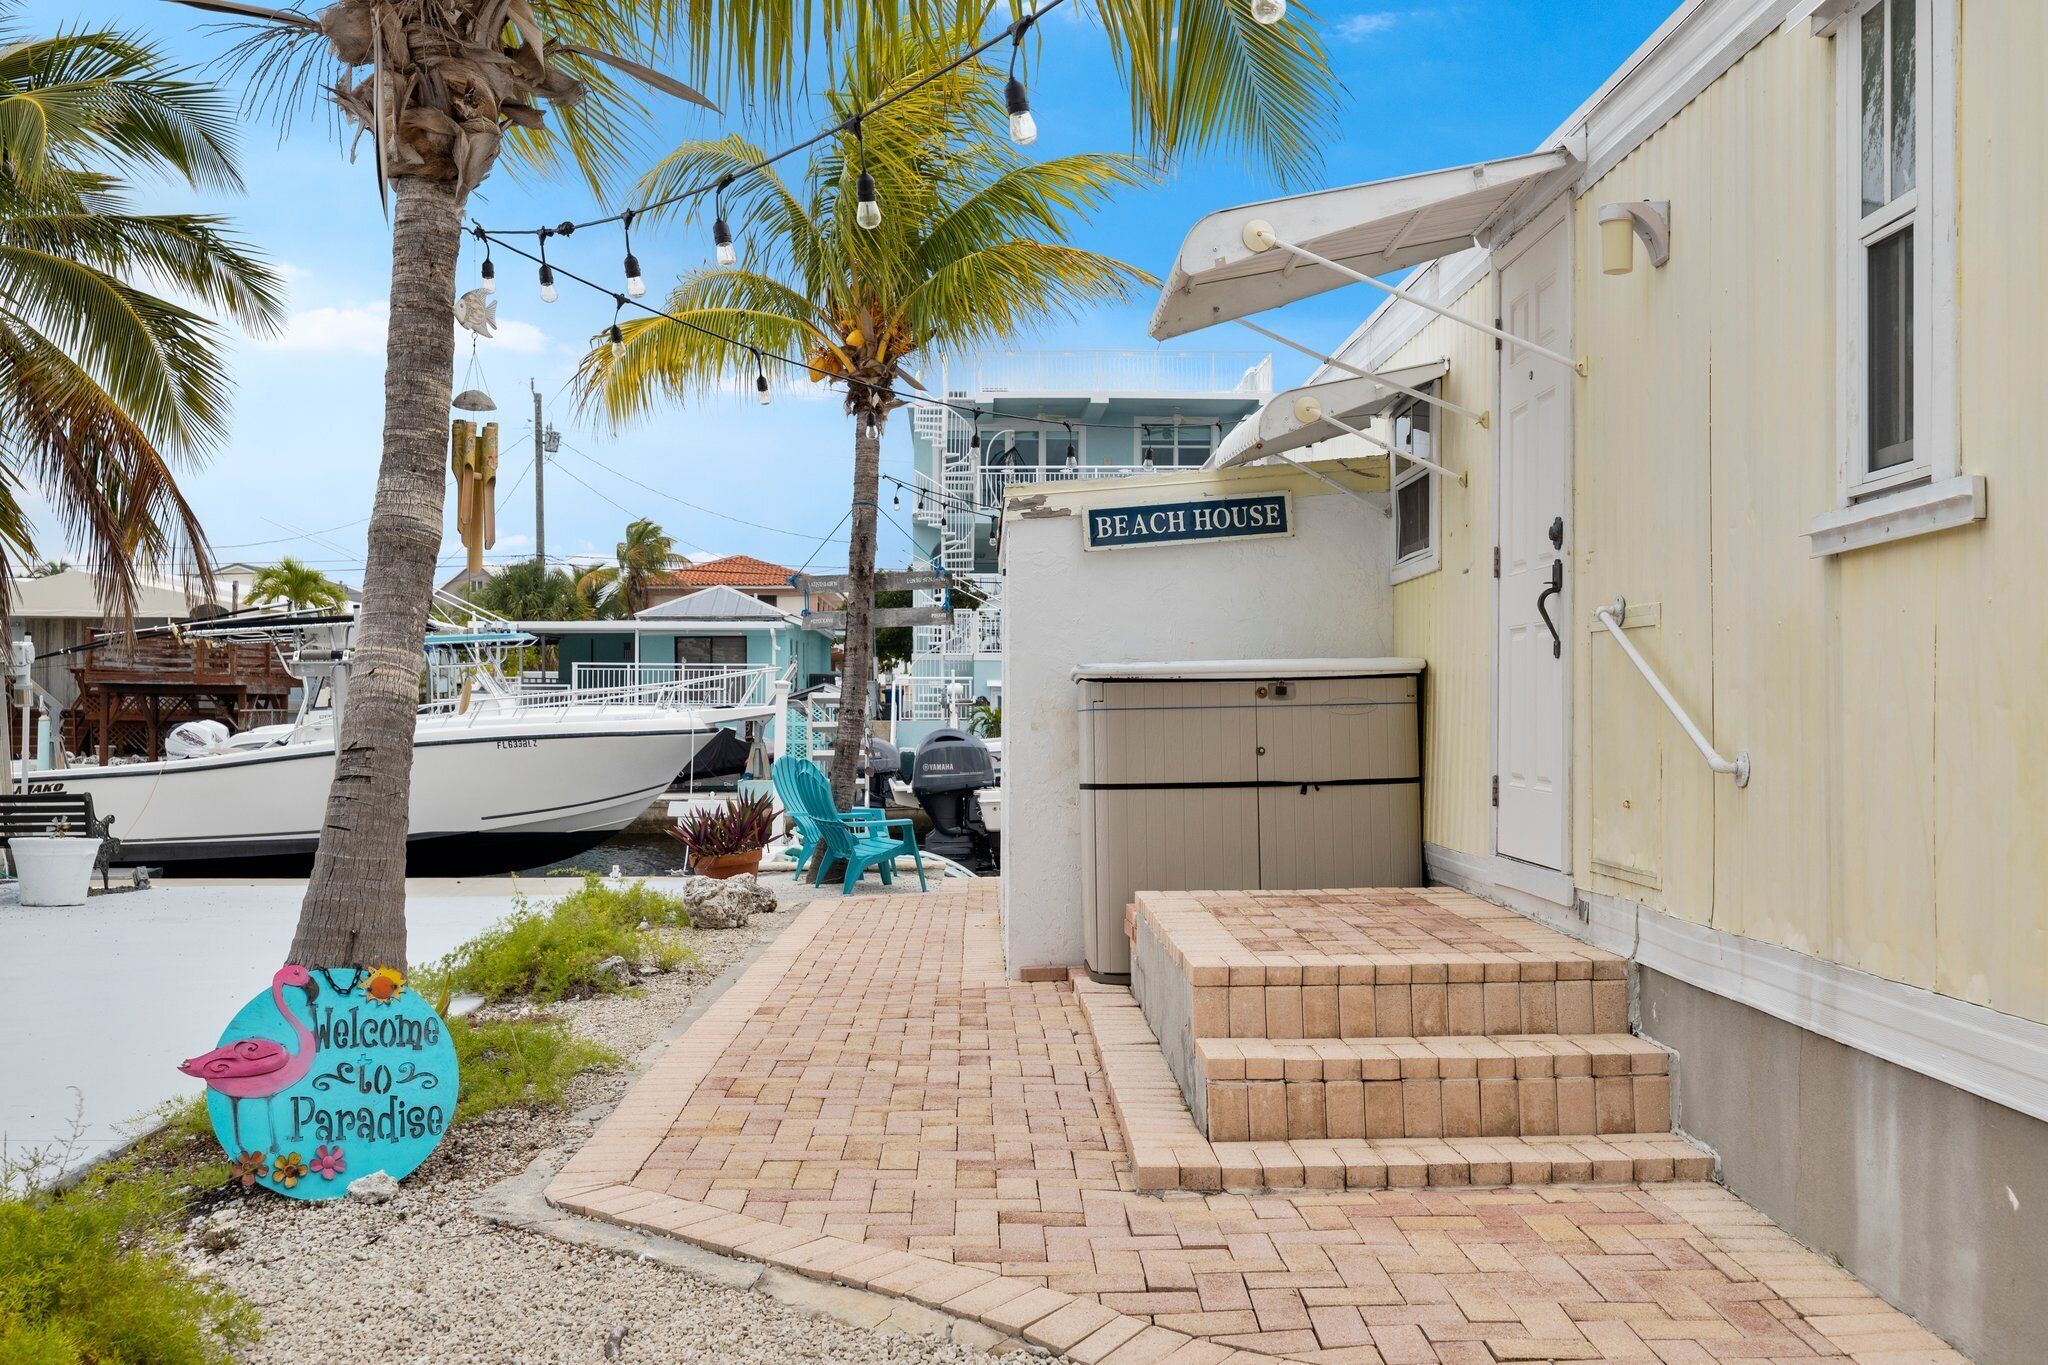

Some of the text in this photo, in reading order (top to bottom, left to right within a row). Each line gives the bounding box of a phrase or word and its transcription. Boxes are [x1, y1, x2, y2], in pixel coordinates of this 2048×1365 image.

[1095, 505, 1281, 539] BEACH HOUSE
[930, 763, 953, 771] YAMAHA
[311, 1005, 440, 1053] Welcome
[357, 1053, 392, 1095] to
[290, 1096, 443, 1143] Paradise
